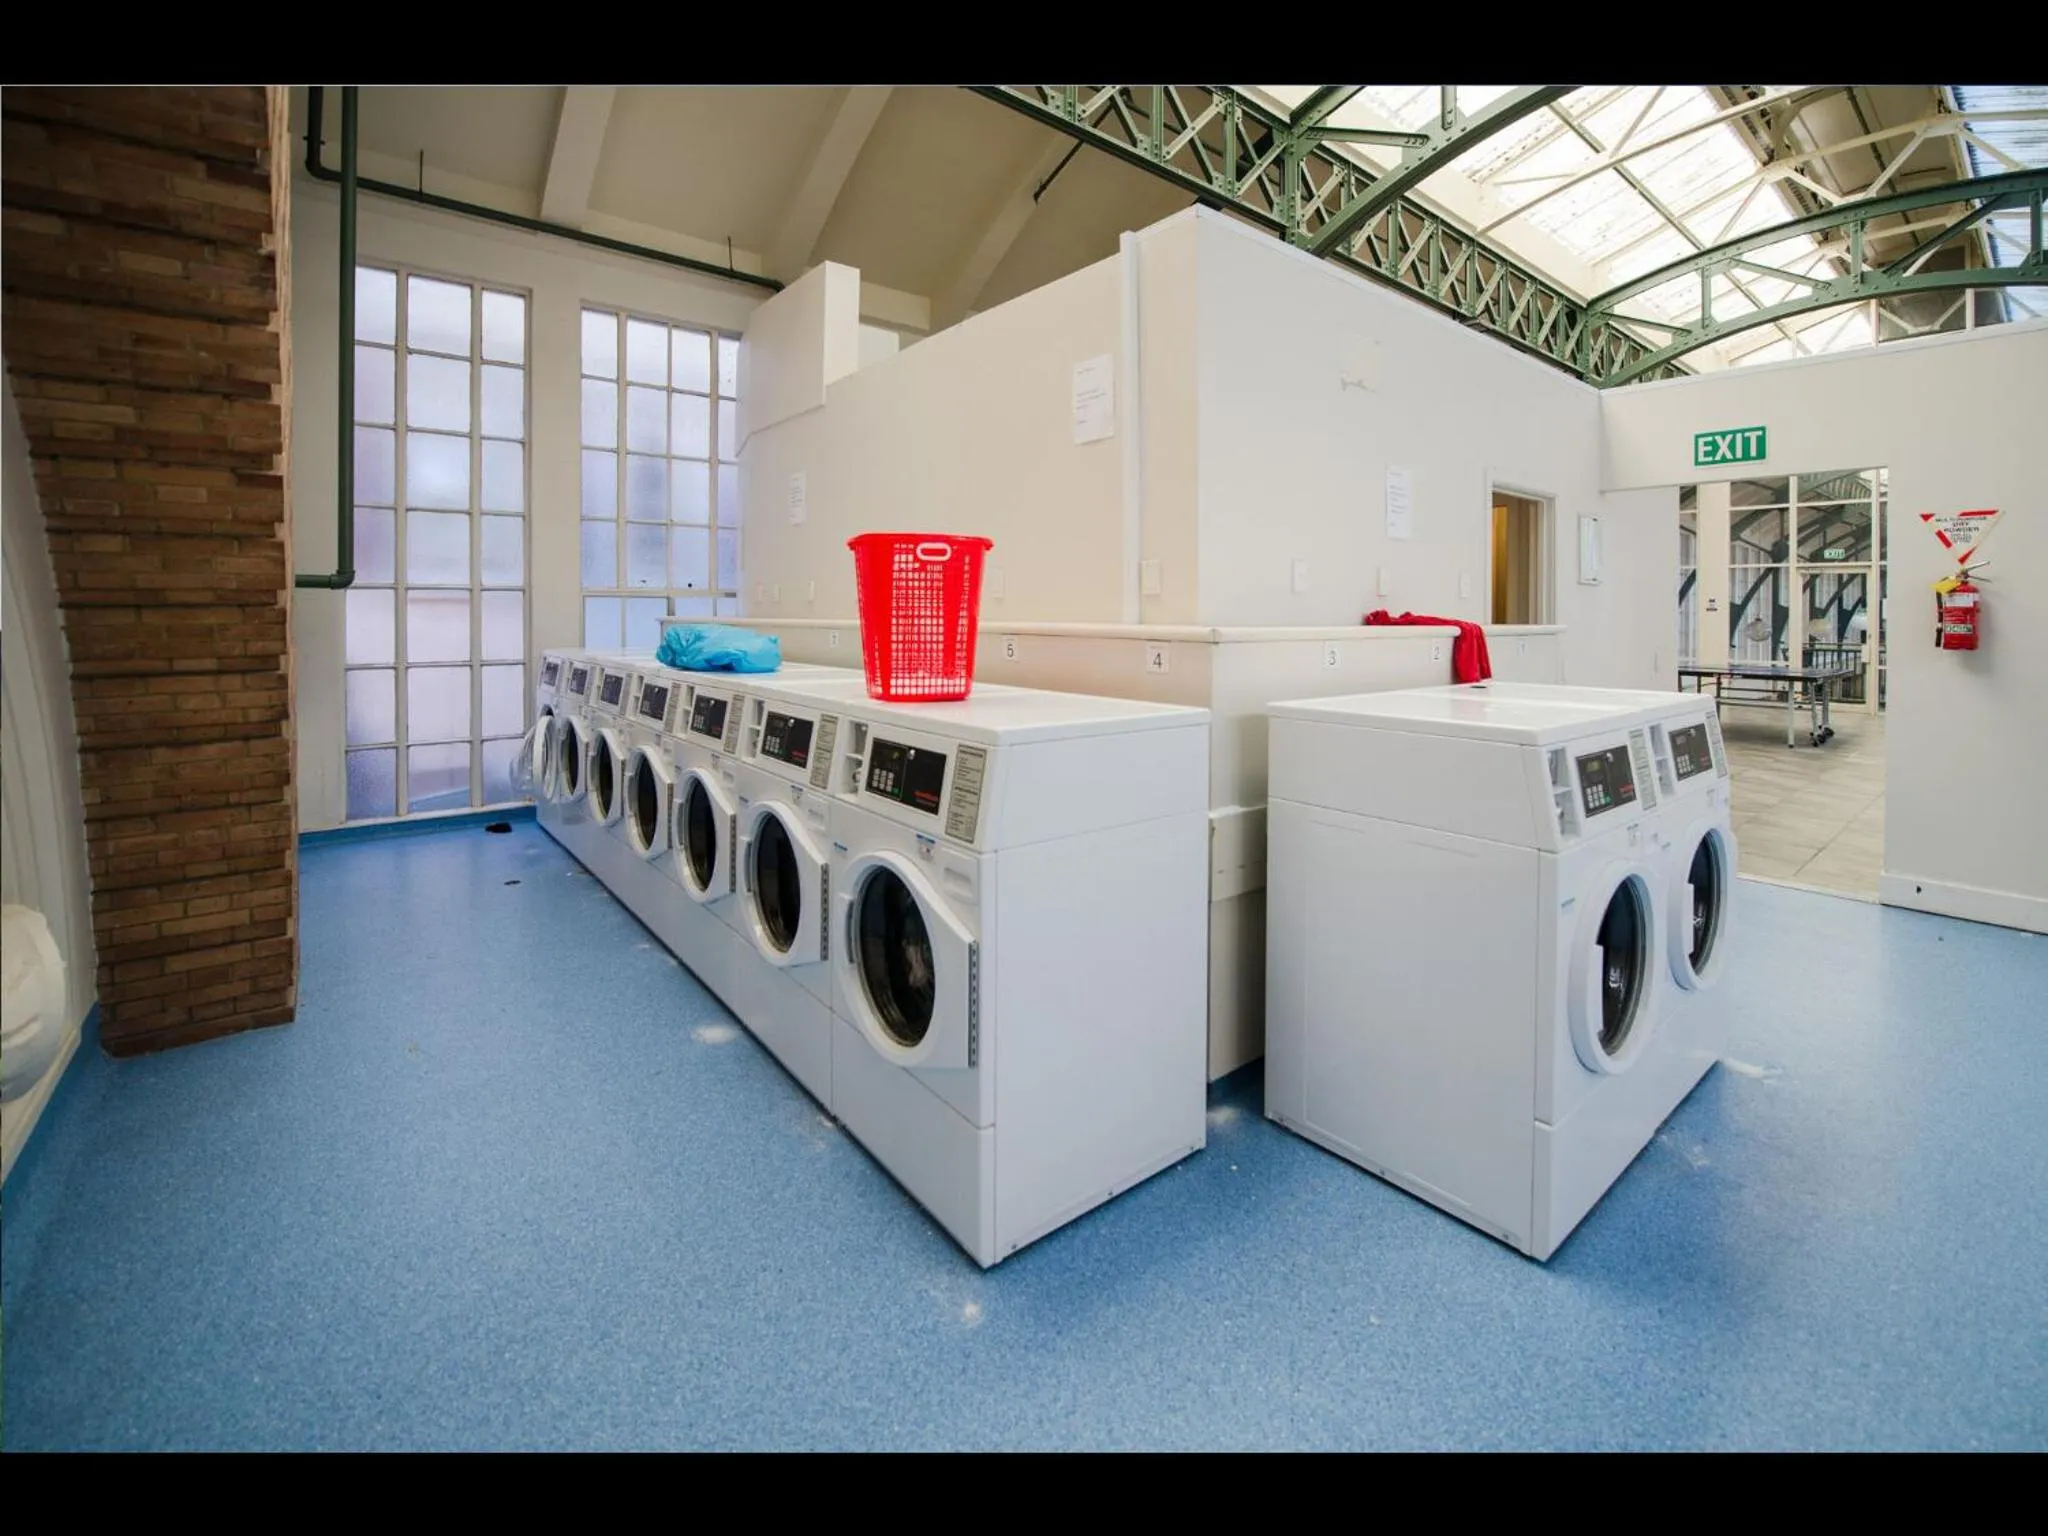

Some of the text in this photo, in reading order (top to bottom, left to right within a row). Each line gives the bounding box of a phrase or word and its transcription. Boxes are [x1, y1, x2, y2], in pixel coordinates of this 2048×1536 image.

[1697, 430, 1763, 462] EXIT
[1006, 643, 1014, 658] 5
[1328, 650, 1337, 666] 3
[1152, 652, 1163, 669] 4
